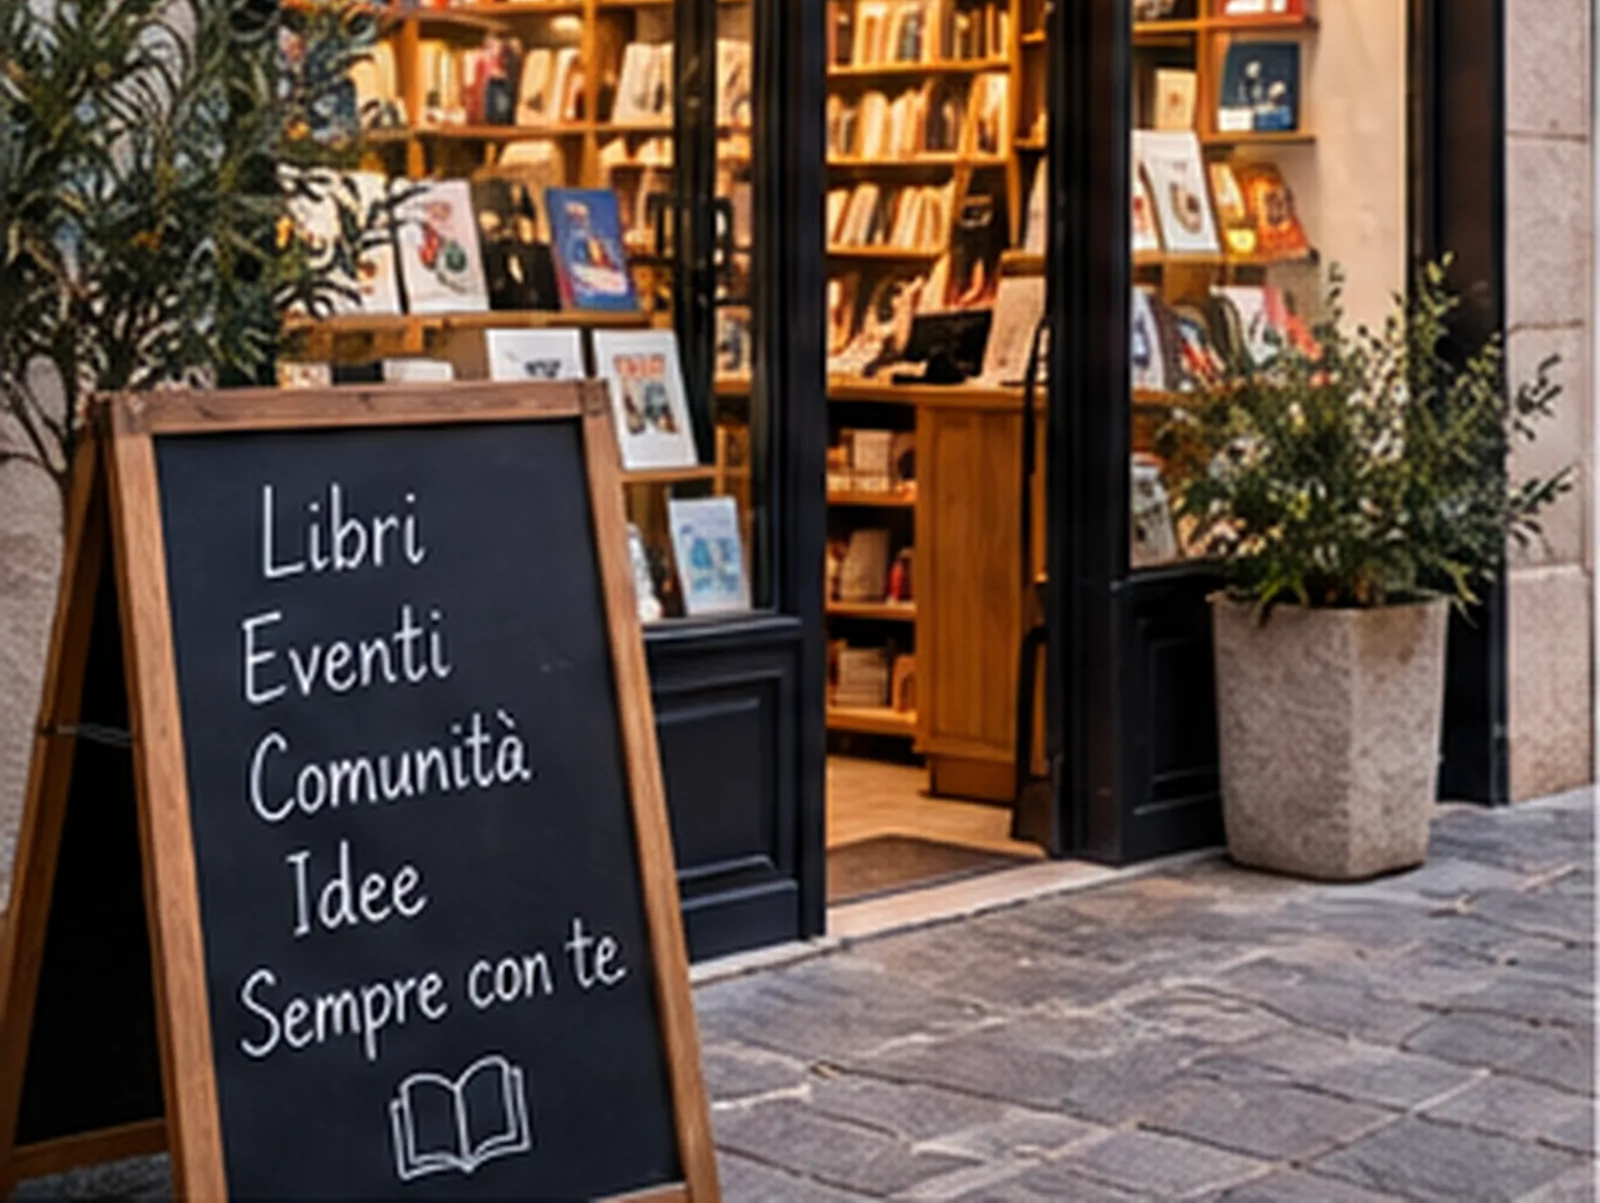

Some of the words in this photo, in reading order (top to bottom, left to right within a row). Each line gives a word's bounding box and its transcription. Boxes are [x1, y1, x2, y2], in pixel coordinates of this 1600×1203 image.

[263, 483, 425, 578] Libri
[243, 604, 451, 704] Eventi
[251, 708, 532, 821] Comunità
[286, 840, 427, 936] Idee
[241, 969, 447, 1060] Sempre
[468, 952, 553, 1009] con
[566, 918, 626, 988] te
